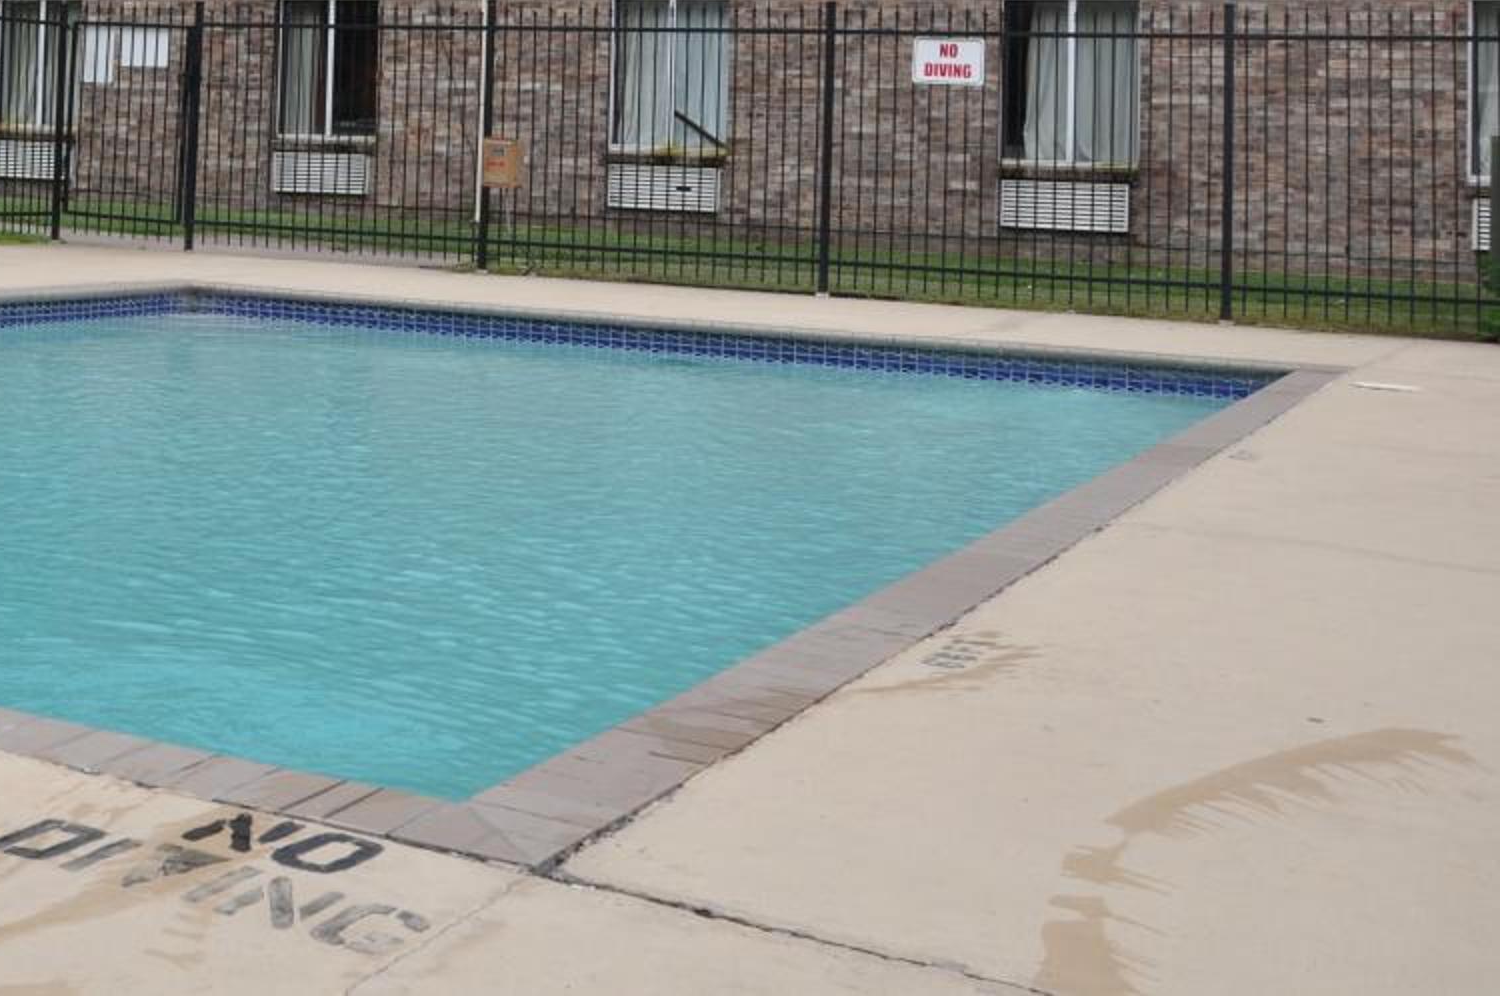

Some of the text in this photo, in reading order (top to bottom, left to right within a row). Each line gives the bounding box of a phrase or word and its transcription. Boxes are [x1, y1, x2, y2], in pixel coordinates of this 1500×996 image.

[939, 43, 959, 58] NO
[924, 62, 973, 79] DIVING
[181, 812, 384, 873] NO
